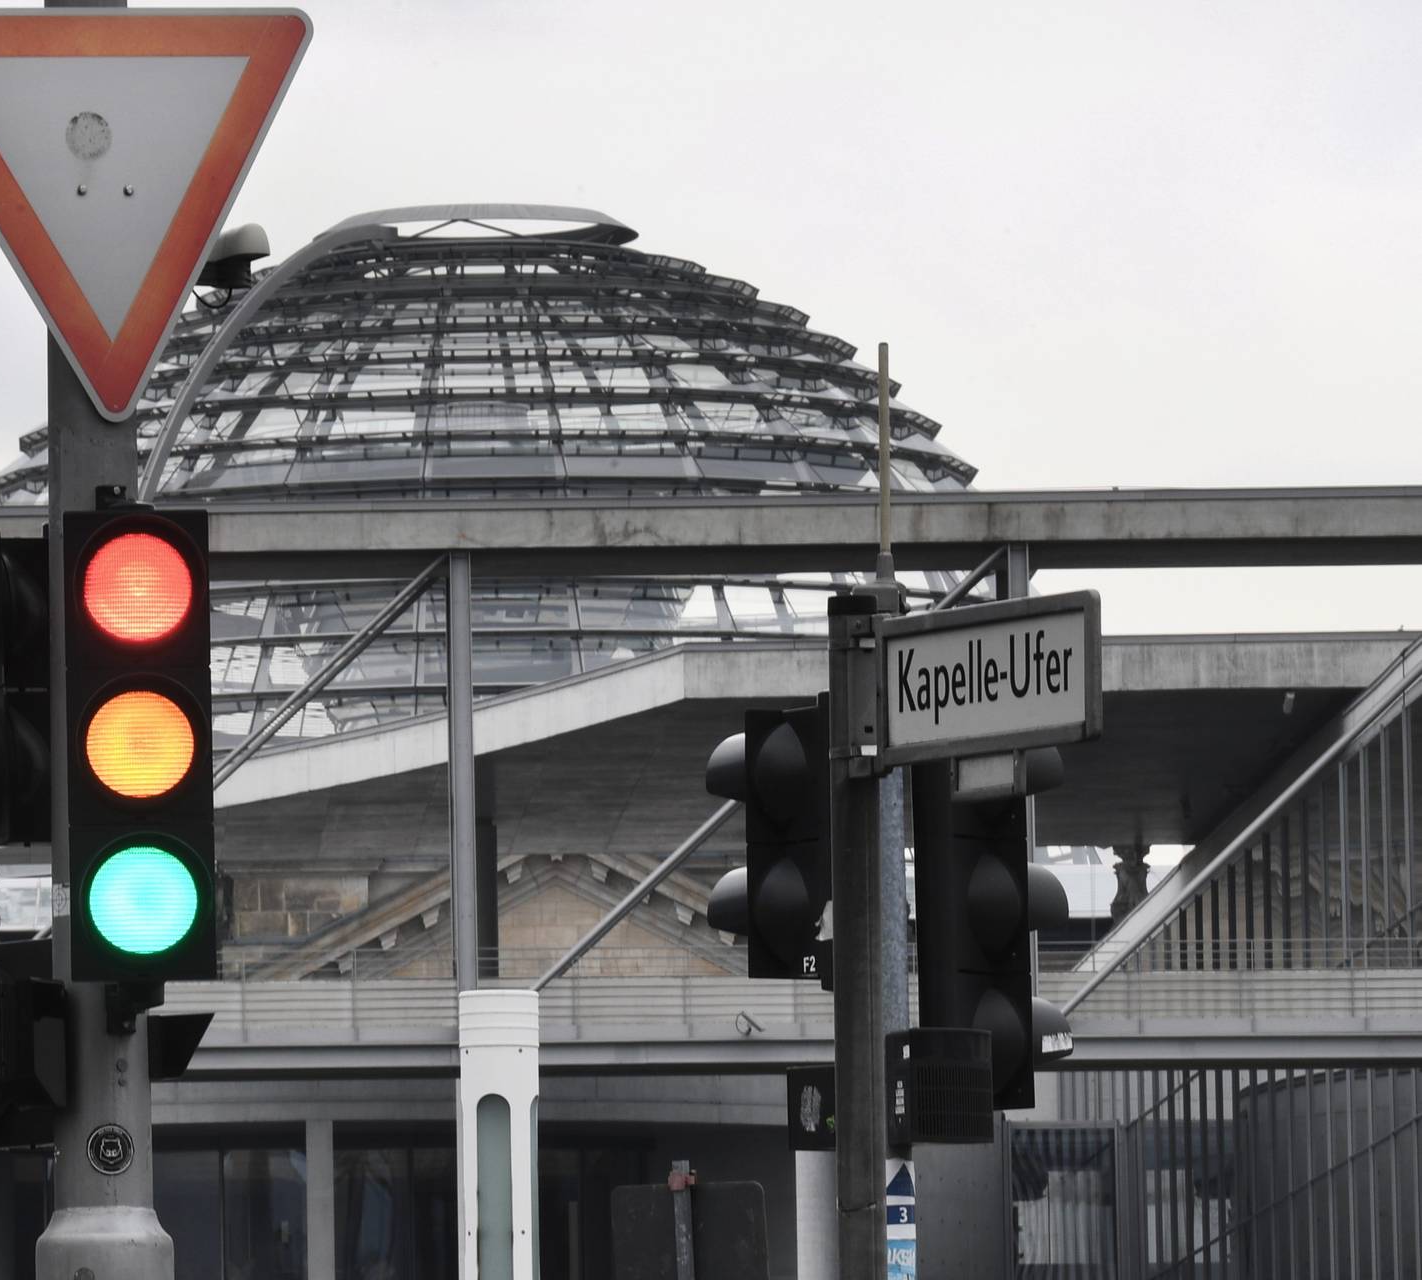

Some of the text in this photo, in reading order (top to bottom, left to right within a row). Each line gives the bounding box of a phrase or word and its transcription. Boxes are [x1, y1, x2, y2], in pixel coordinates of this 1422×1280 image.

[898, 630, 1072, 725] Kapelle-Ufer
[803, 955, 816, 973] F2
[899, 1207, 908, 1223] 3
